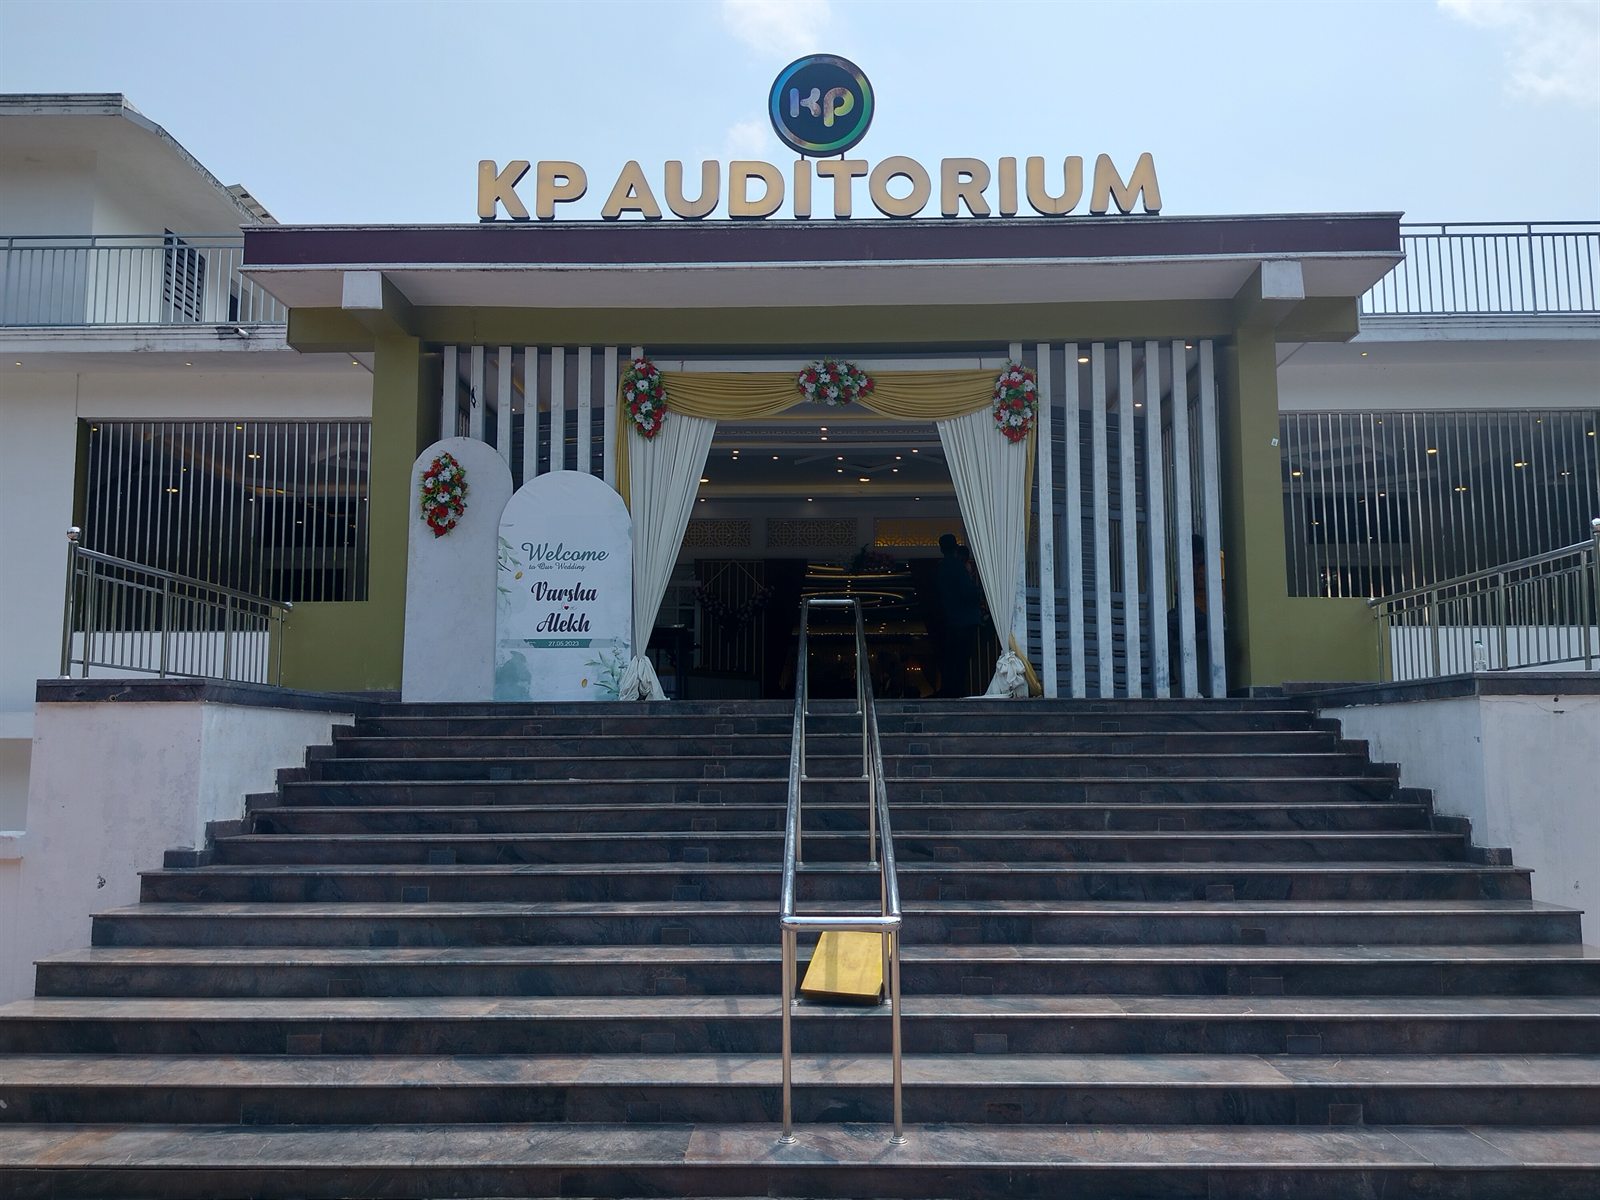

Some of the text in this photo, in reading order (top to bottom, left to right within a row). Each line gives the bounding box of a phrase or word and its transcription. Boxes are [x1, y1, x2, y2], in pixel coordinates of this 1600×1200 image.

[479, 152, 1162, 221] KP AUDITORIUM
[521, 542, 609, 561] Welcome
[537, 562, 553, 570] Our
[555, 562, 585, 572] Wedding
[531, 581, 598, 602] Varsha
[536, 612, 591, 632] Alekh
